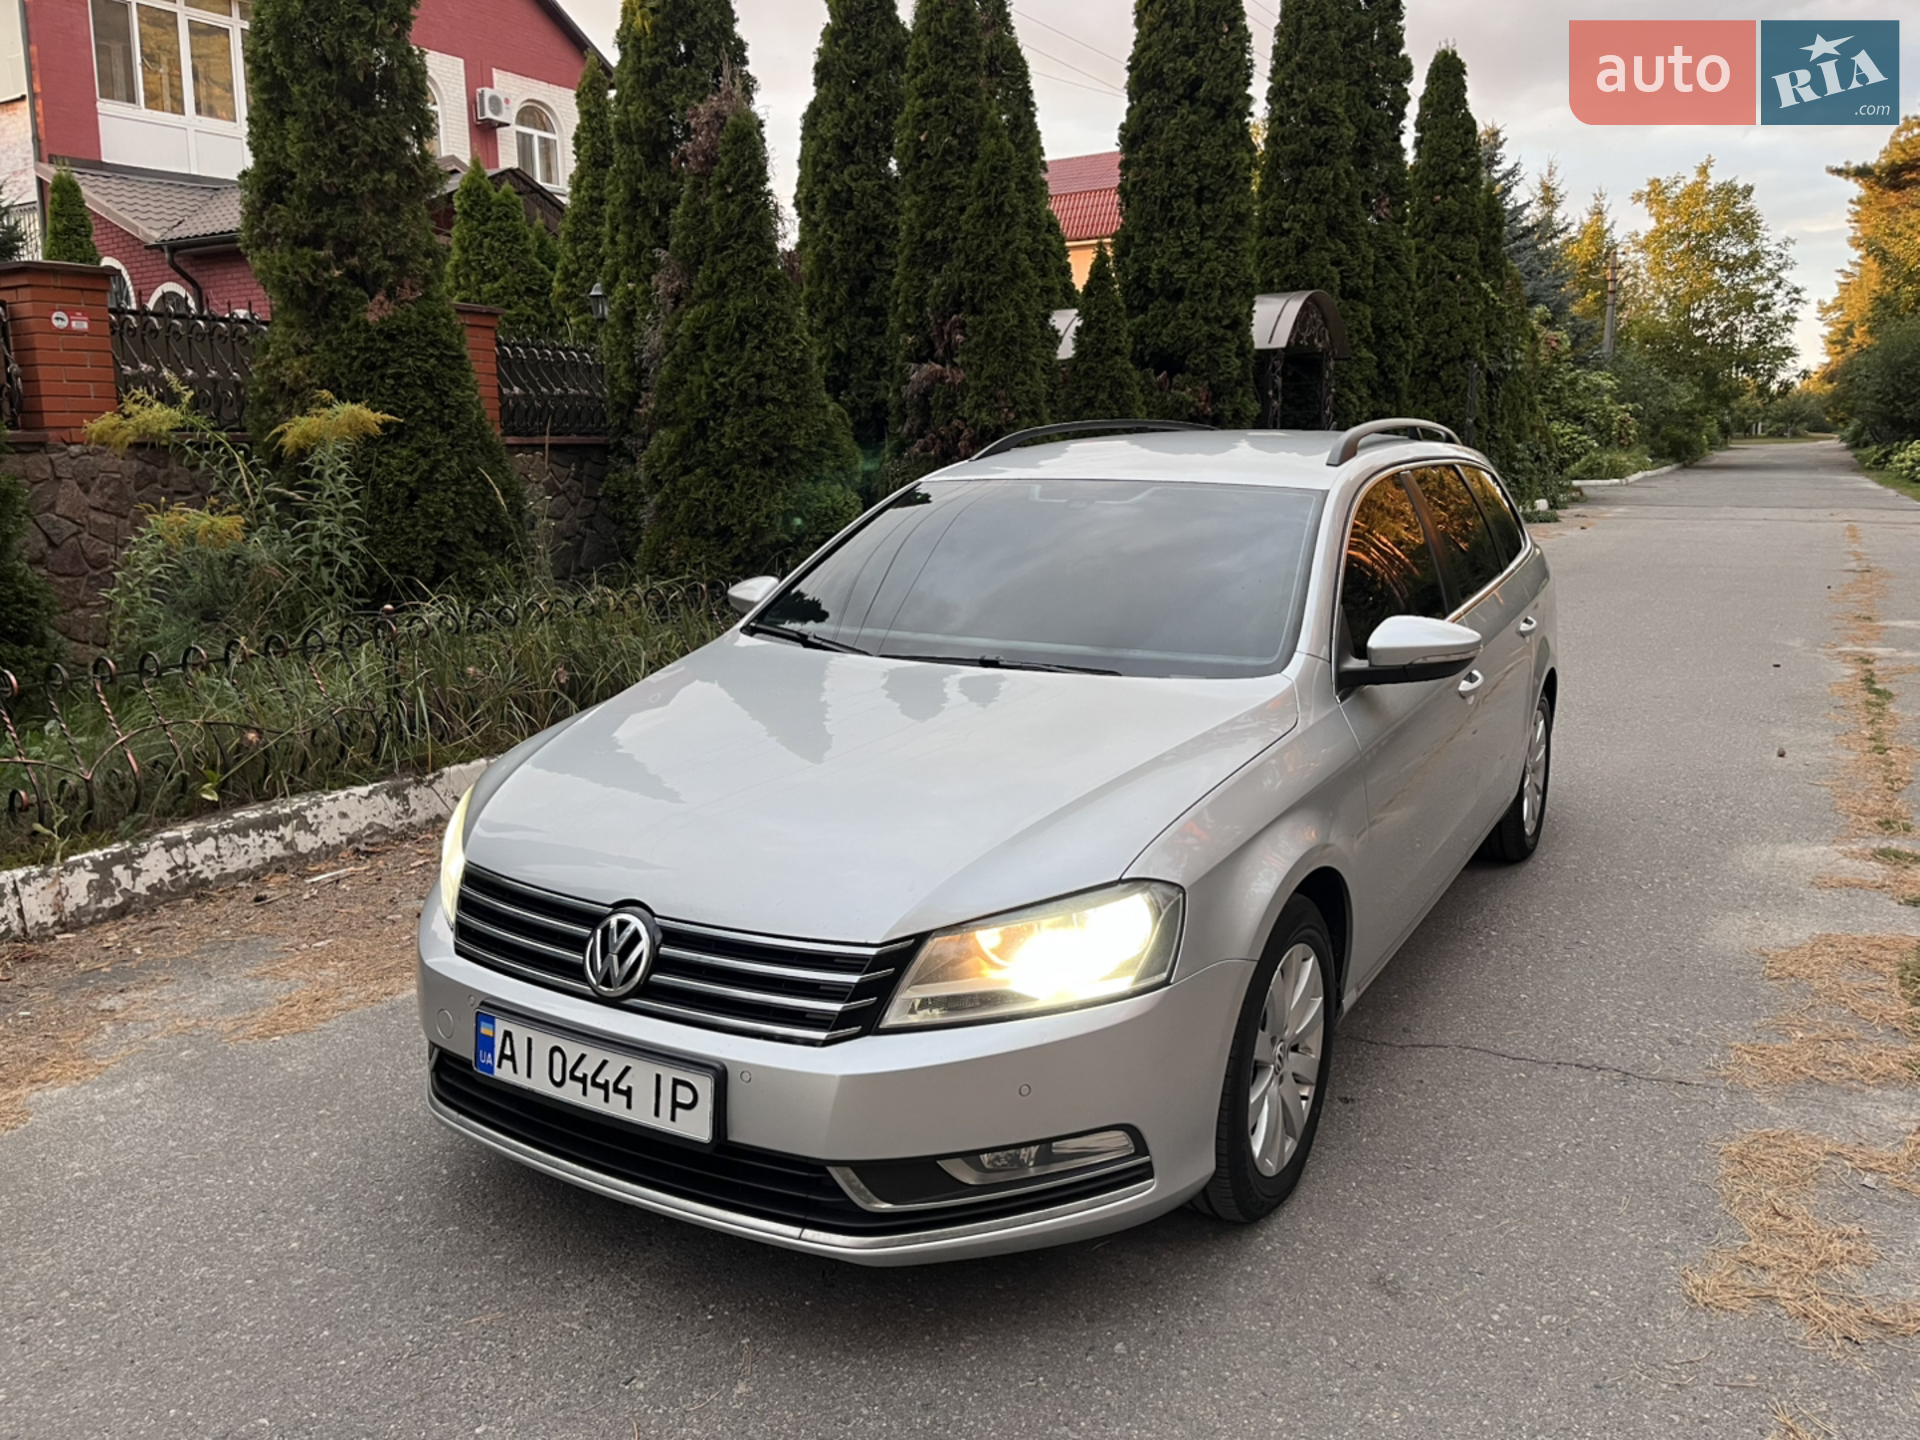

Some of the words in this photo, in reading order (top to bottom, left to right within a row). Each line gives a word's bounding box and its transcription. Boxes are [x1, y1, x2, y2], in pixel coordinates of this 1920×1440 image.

[479, 1050, 493, 1066] UA
[497, 1029, 533, 1079] AI
[548, 1045, 633, 1110] 0444
[653, 1072, 699, 1122] IP
